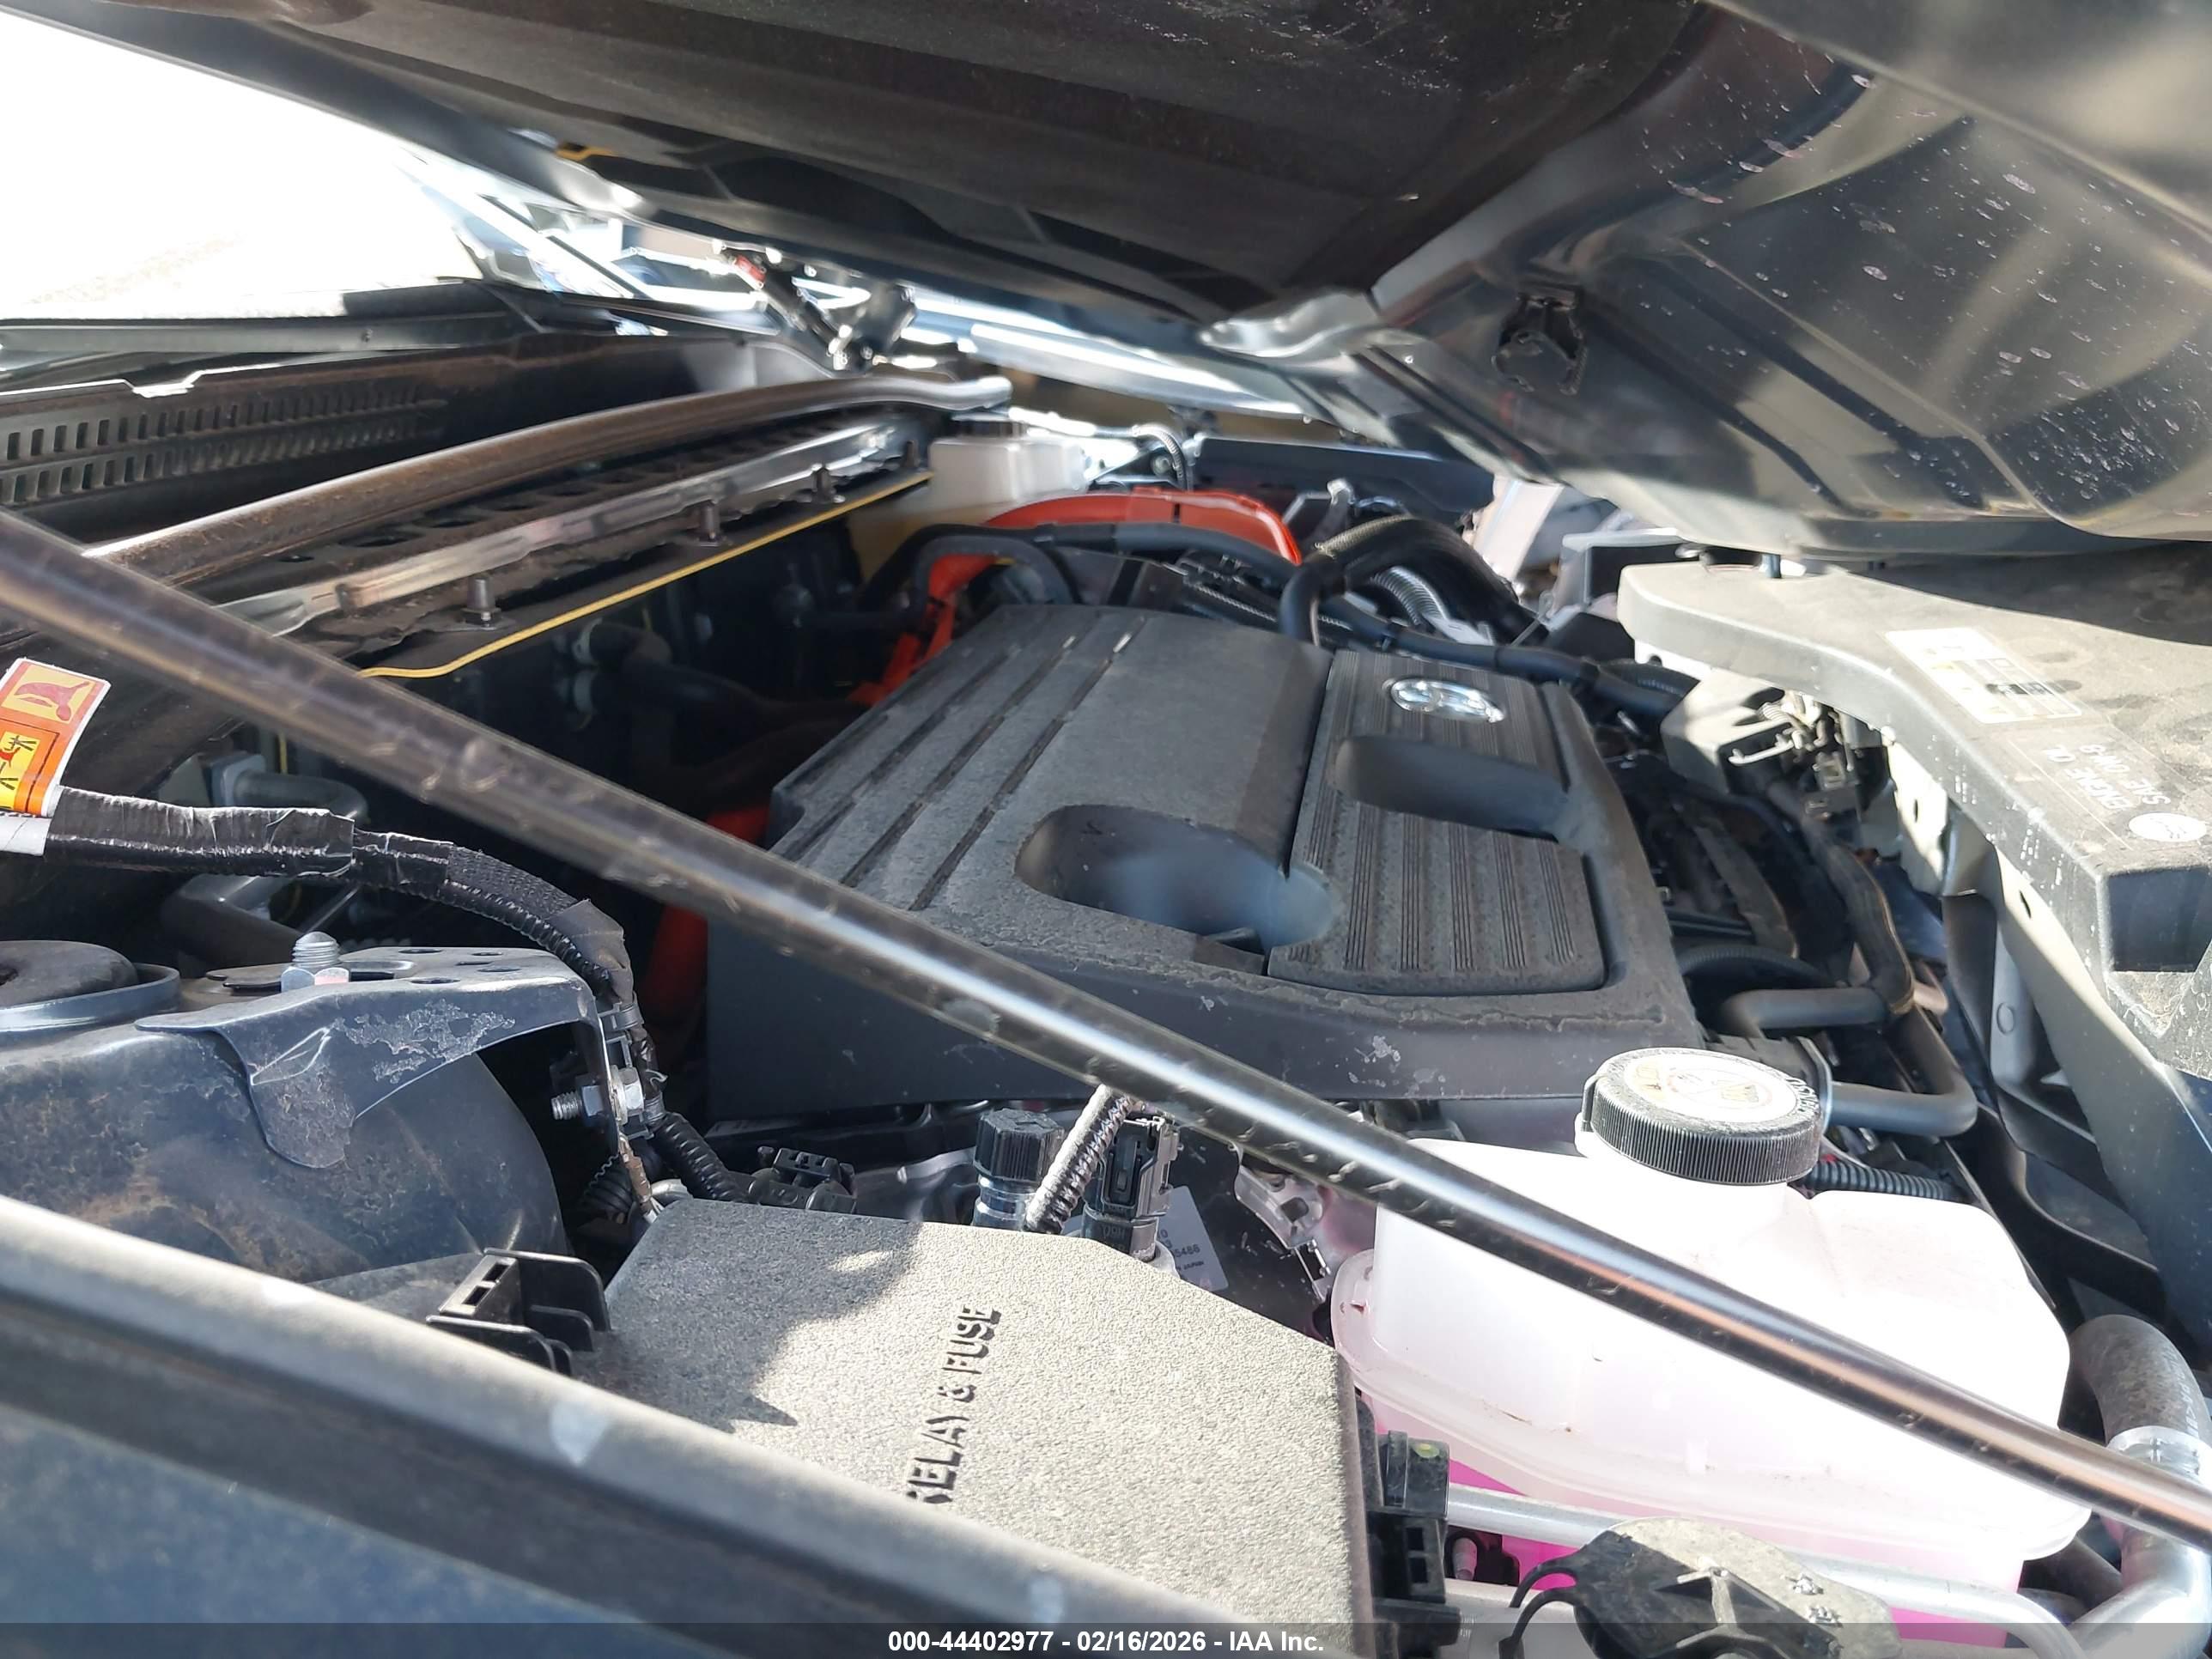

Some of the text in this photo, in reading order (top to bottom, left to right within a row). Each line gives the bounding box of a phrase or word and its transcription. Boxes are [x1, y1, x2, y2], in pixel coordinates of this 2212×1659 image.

[2063, 767, 2134, 809] ENGINE
[2123, 779, 2172, 805] SAE
[941, 1304, 1003, 1376] FUSE
[936, 1383, 977, 1403] &
